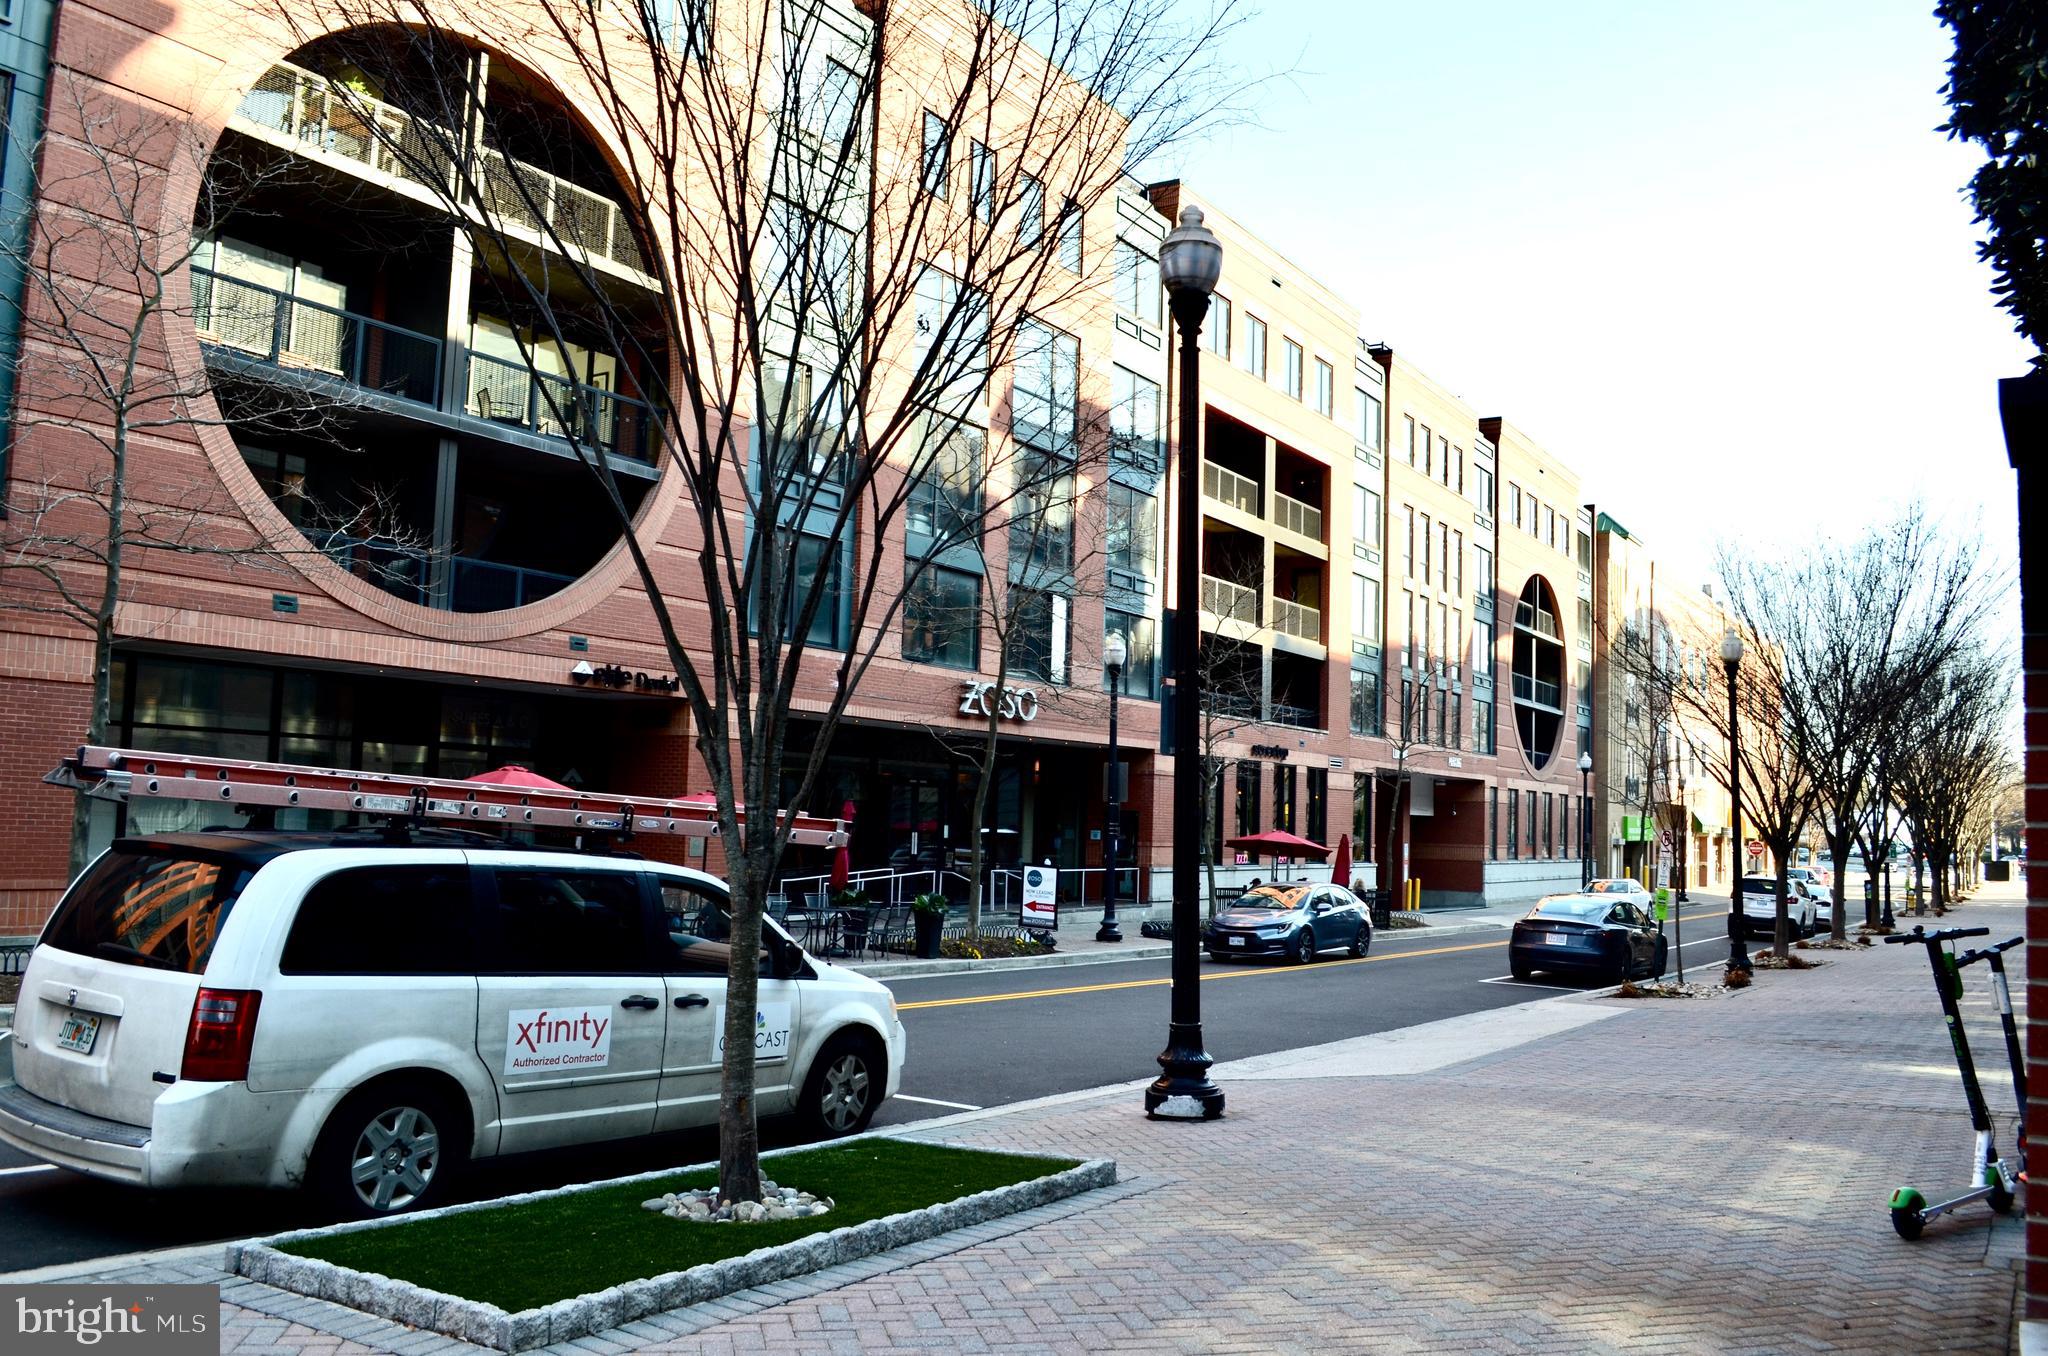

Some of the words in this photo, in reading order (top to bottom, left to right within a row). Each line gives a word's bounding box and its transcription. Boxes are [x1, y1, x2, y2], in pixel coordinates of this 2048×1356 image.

[515, 1011, 608, 1053] xfinity
[512, 1056, 560, 1068] Authorized
[562, 1053, 606, 1065] Contractor
